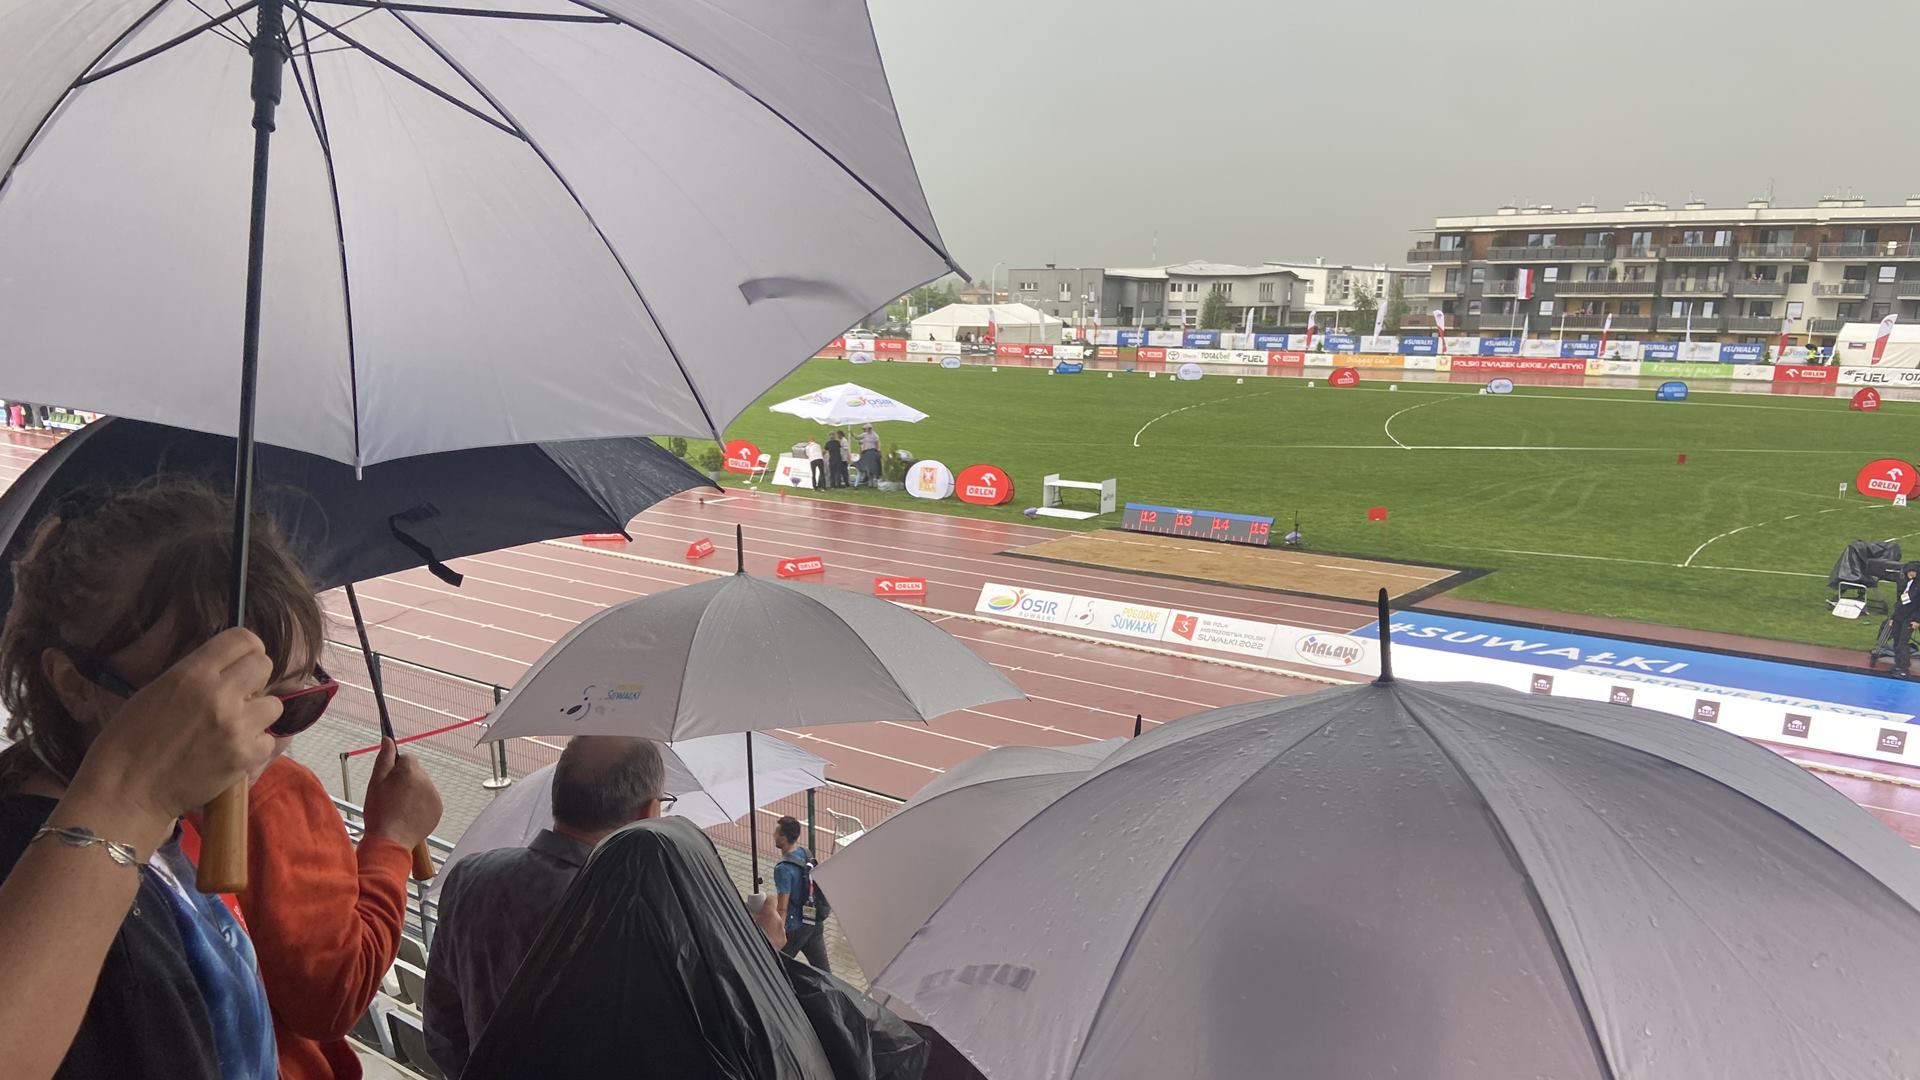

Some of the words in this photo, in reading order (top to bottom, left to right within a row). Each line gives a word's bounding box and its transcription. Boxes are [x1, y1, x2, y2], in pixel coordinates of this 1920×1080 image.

[1481, 361, 1515, 369] ZWIĄZEK
[1854, 373, 1889, 382] FUEL
[968, 487, 994, 496] ORLEN
[1871, 481, 1898, 490] ORLEN
[1141, 510, 1157, 522] 12
[1176, 515, 1193, 526] 13
[1213, 518, 1230, 530] 14
[1251, 522, 1268, 534] 15
[800, 562, 819, 570] ORLEN
[1021, 598, 1058, 615] OSIR
[1122, 607, 1160, 622] POGODNE
[1112, 614, 1157, 634] SUWAŁKI
[1197, 634, 1238, 646] SUWAŁKI
[1239, 640, 1264, 650] 2022
